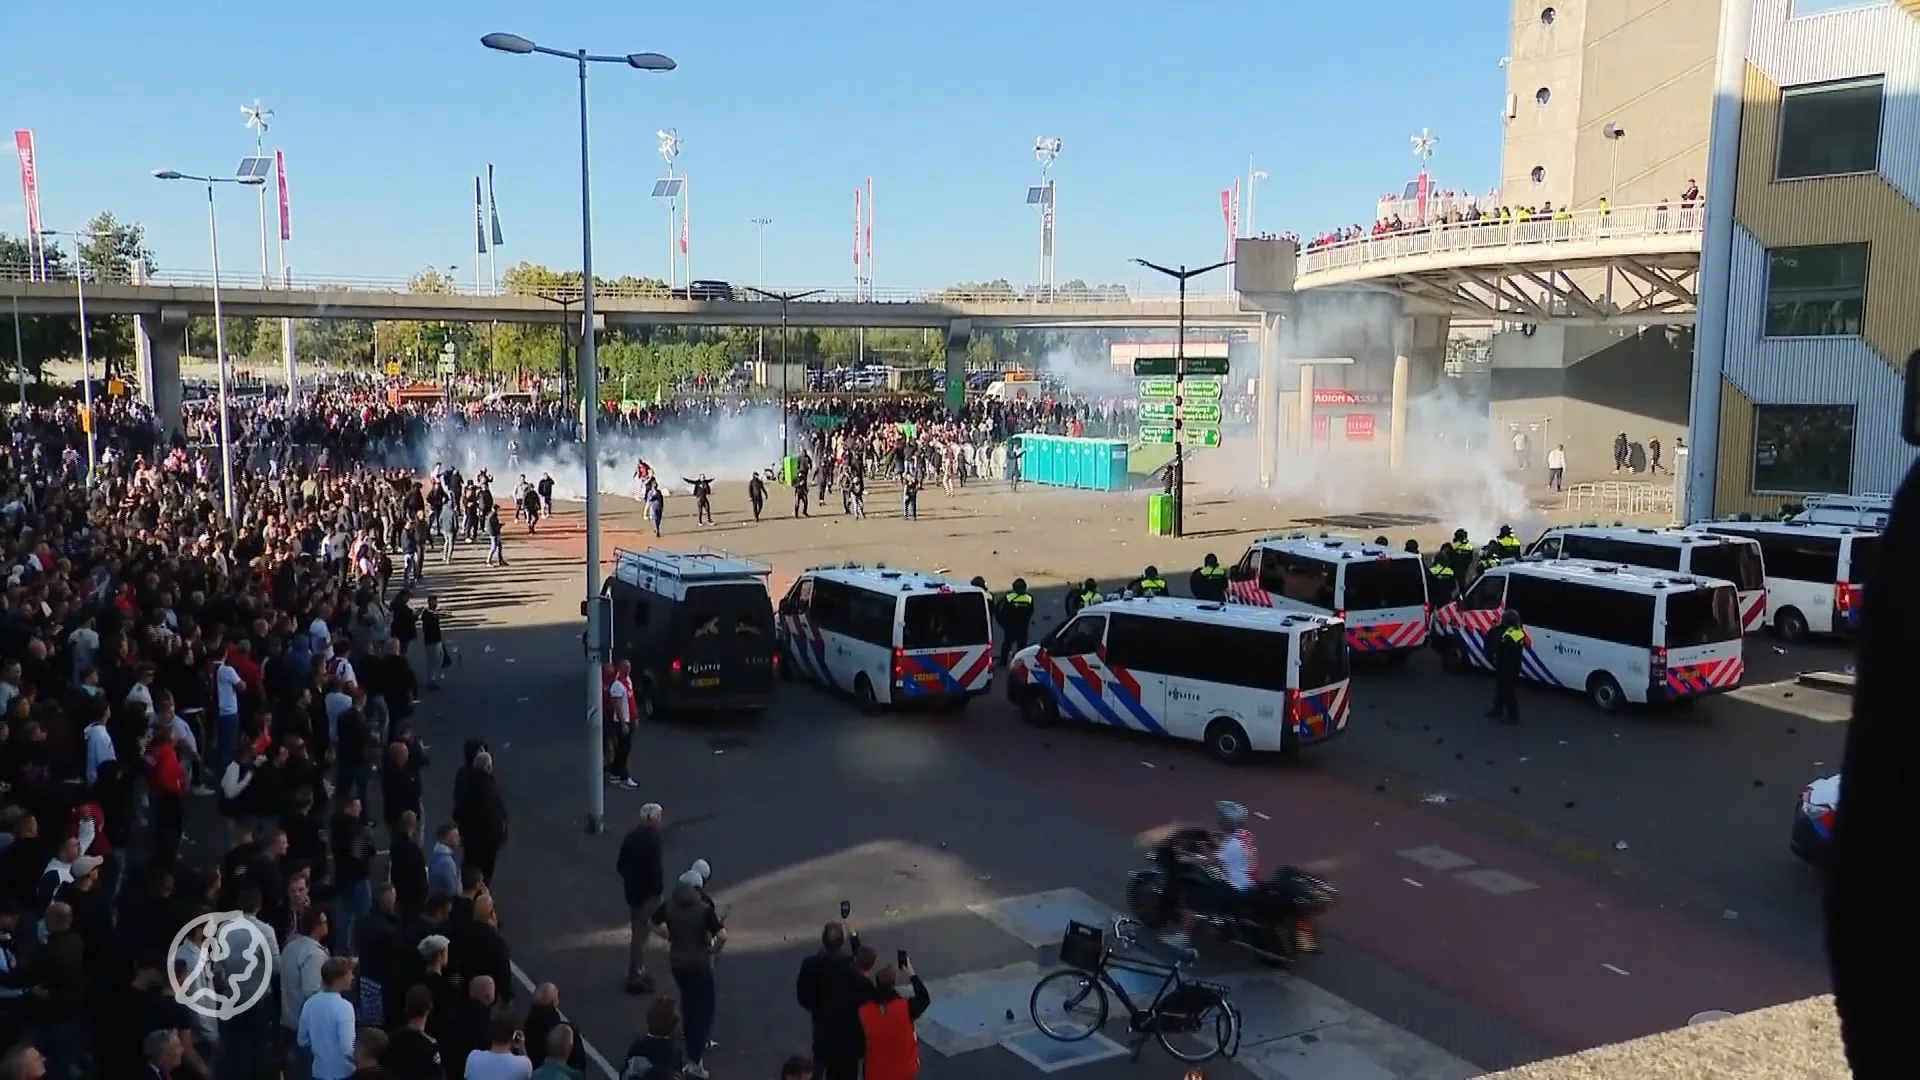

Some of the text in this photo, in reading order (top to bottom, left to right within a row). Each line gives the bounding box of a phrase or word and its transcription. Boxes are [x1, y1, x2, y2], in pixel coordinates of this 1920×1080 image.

[1314, 394, 1346, 403] ADION
[1554, 642, 1581, 656] POLITIE
[687, 663, 721, 674] POLITIE
[1168, 687, 1200, 702] POLITIE
